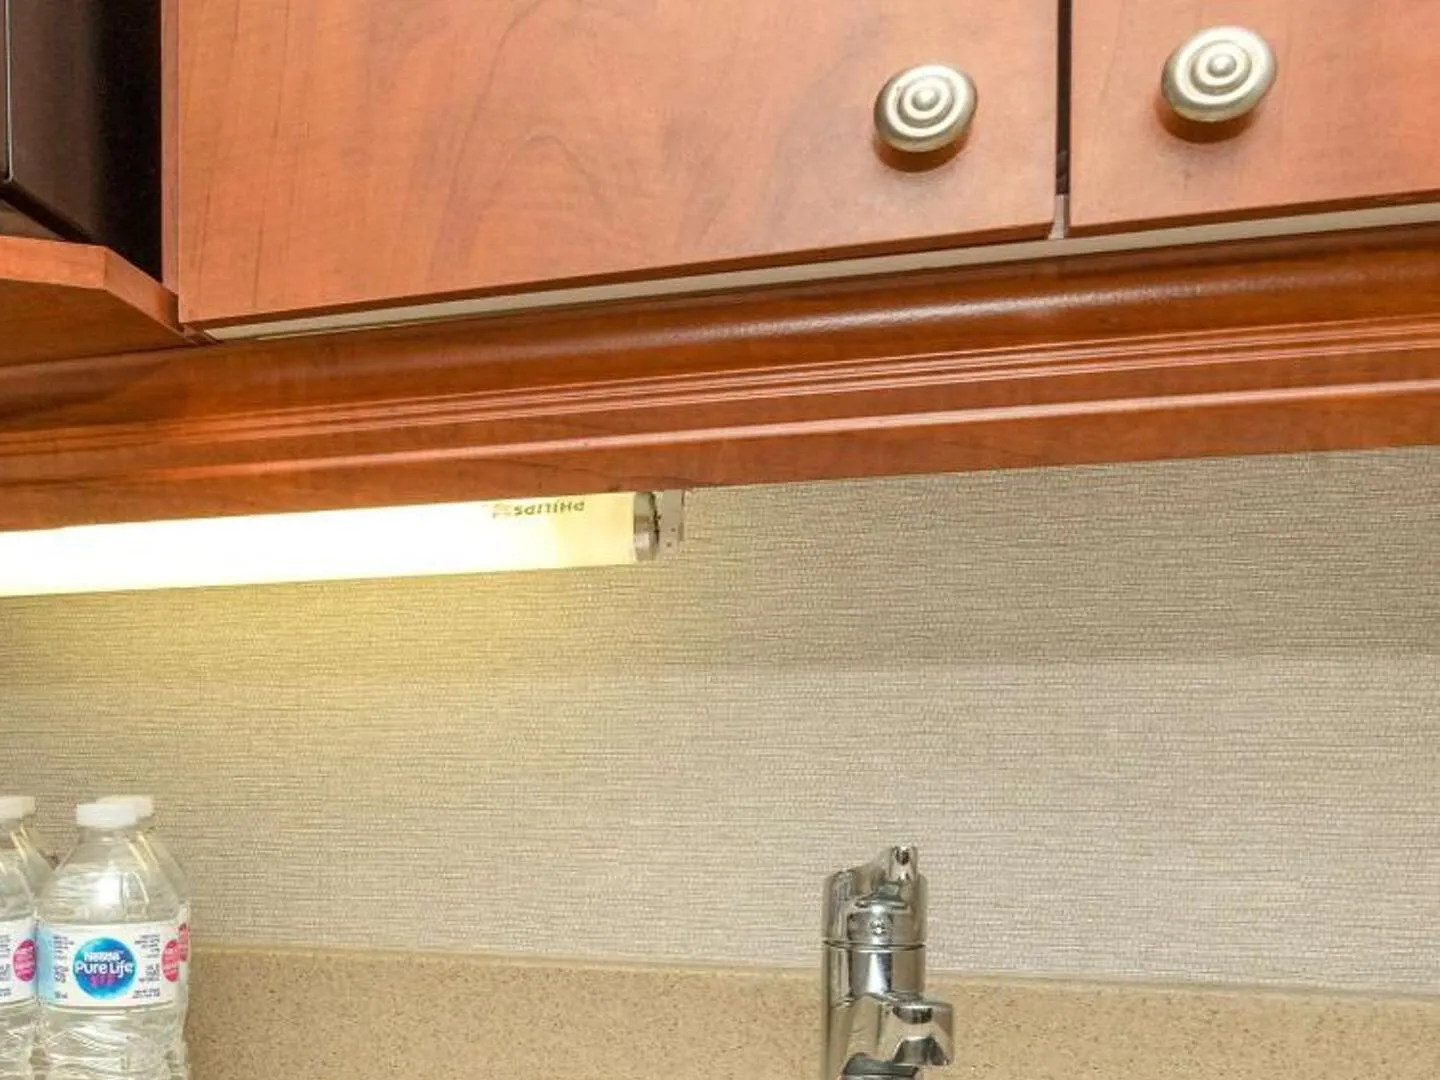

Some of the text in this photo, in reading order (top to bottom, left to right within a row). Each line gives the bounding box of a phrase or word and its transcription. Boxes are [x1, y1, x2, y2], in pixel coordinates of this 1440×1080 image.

[513, 501, 585, 516] PHILIPS
[75, 961, 108, 974] Pure
[110, 961, 132, 978] Life
